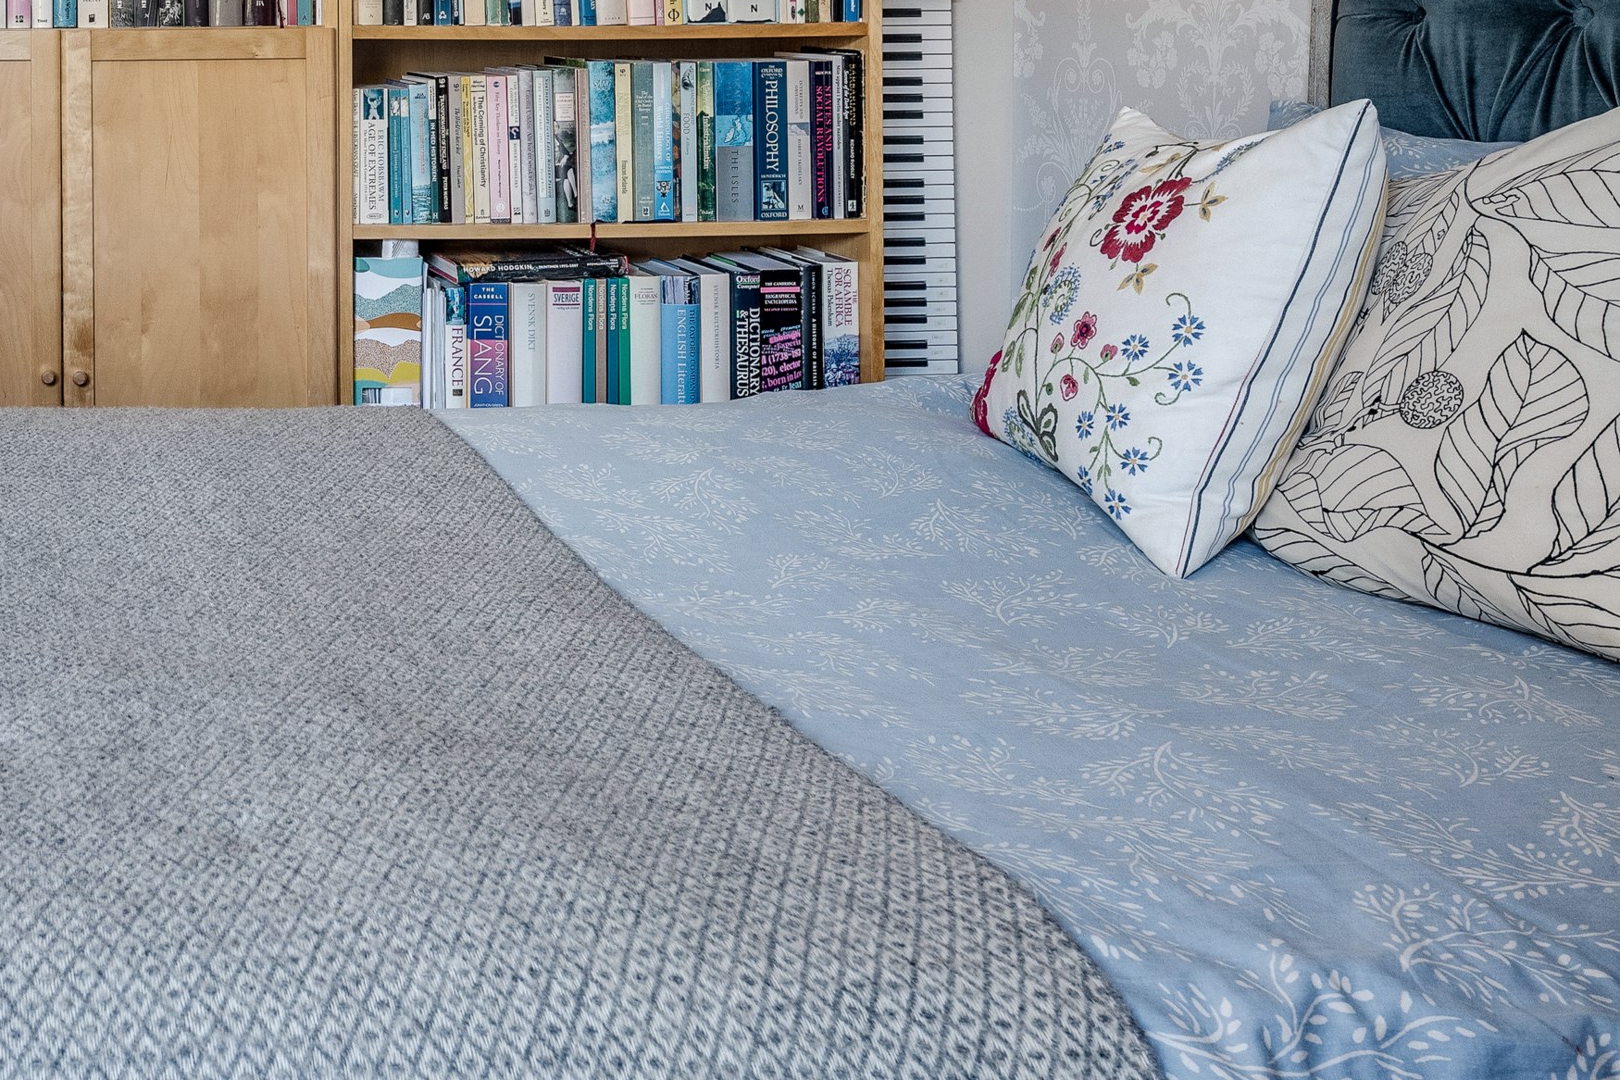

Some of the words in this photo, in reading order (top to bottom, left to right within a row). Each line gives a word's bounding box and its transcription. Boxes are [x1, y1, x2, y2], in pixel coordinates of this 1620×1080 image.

[477, 106, 485, 137] Coming
[816, 85, 824, 124] SOCIAL
[368, 121, 377, 143] AGE
[377, 129, 385, 149] ERIC
[479, 138, 486, 146] of
[765, 80, 779, 171] PHILOSOPHY
[368, 145, 377, 157] OF
[479, 146, 487, 187] Christianity
[731, 149, 739, 171] THE
[816, 127, 824, 202] REVOLUTIONS
[368, 159, 377, 209] EXTREMES
[377, 152, 385, 202] HOBSBAWM
[731, 174, 739, 203] ISLES
[835, 267, 843, 287] FOR
[528, 293, 536, 328] SVENSK
[553, 294, 580, 302] SVERIGE
[736, 310, 748, 318] &
[835, 289, 843, 327] AFRICA
[844, 268, 852, 325] SCRAMBLE
[494, 315, 504, 380] DICTIONARY
[528, 329, 536, 352] DIKT
[677, 309, 687, 359] ENGLISH
[749, 307, 760, 395] DICTIONARY
[452, 327, 464, 386] FRANCE
[473, 315, 492, 395] SLANG
[736, 320, 748, 397] THESAURUS
[811, 351, 817, 359] OF
[494, 382, 504, 395] OF
